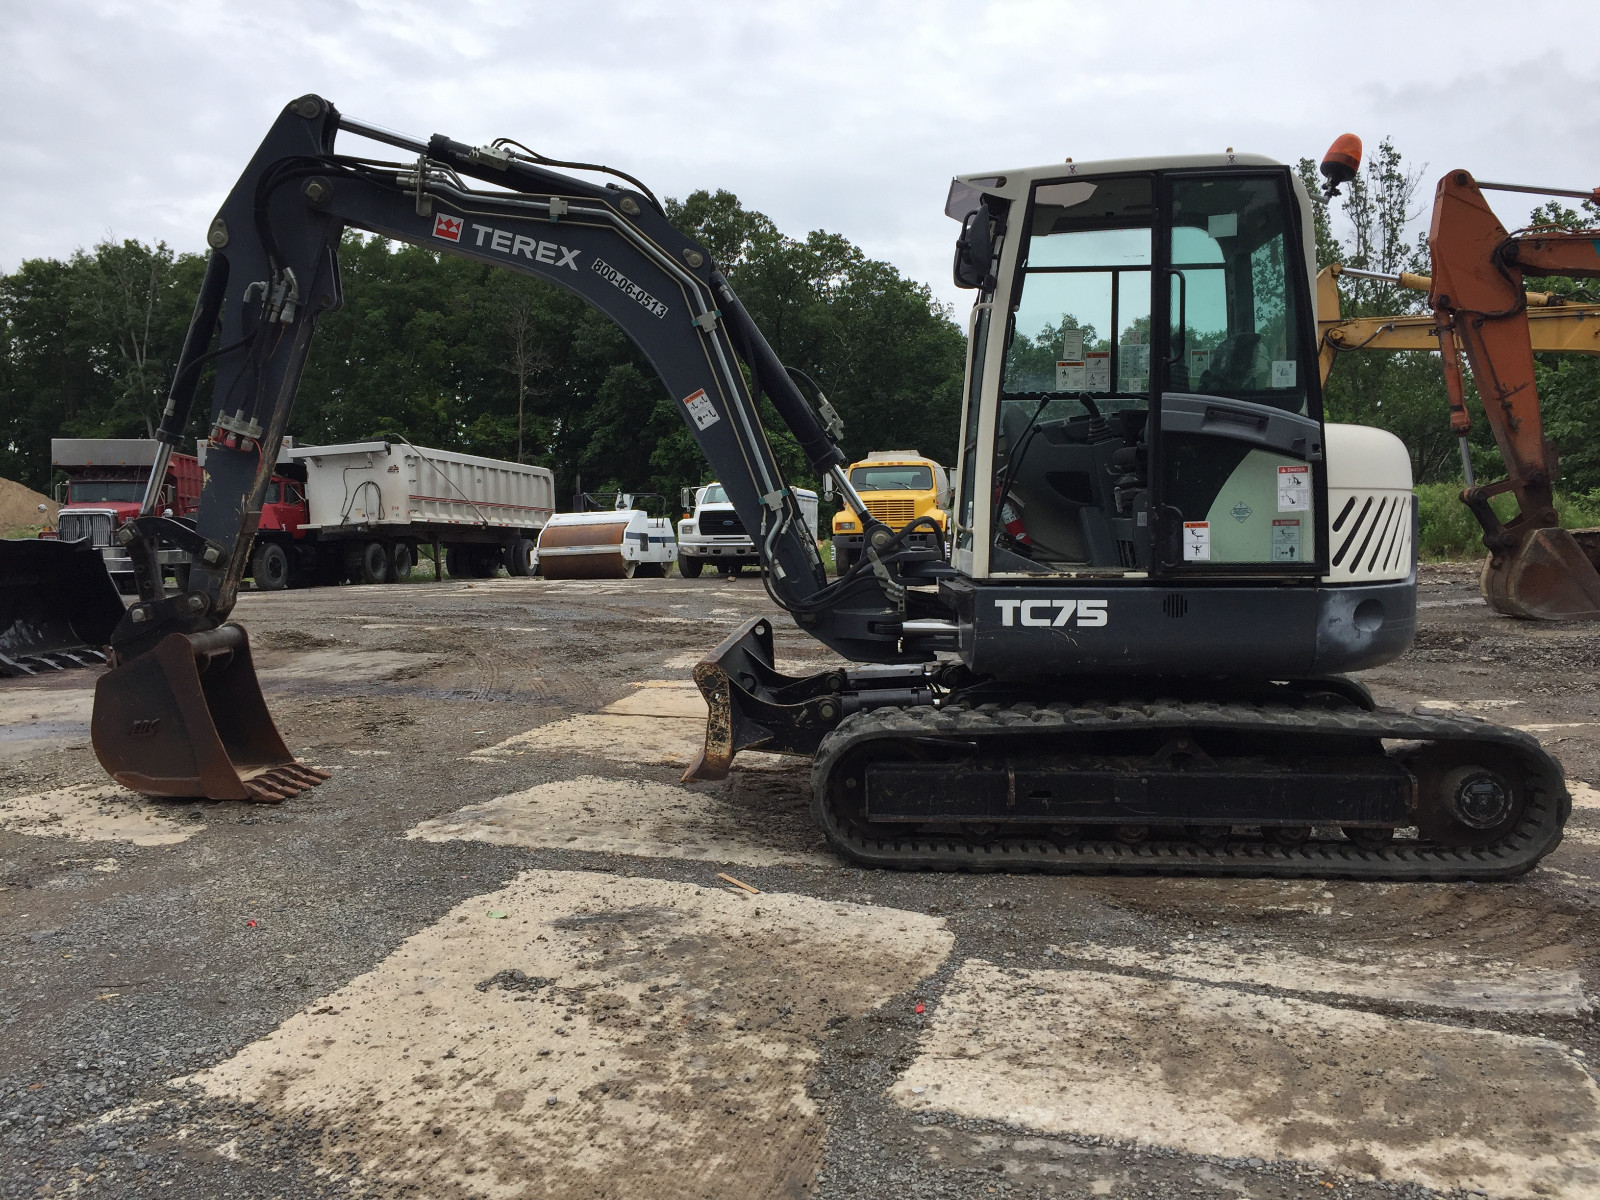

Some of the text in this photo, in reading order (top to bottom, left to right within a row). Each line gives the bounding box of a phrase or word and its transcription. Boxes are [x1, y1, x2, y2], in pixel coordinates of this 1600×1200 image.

[472, 223, 582, 271] TEREX
[593, 259, 668, 319] 800-06-0513
[994, 599, 1108, 627] TC75
